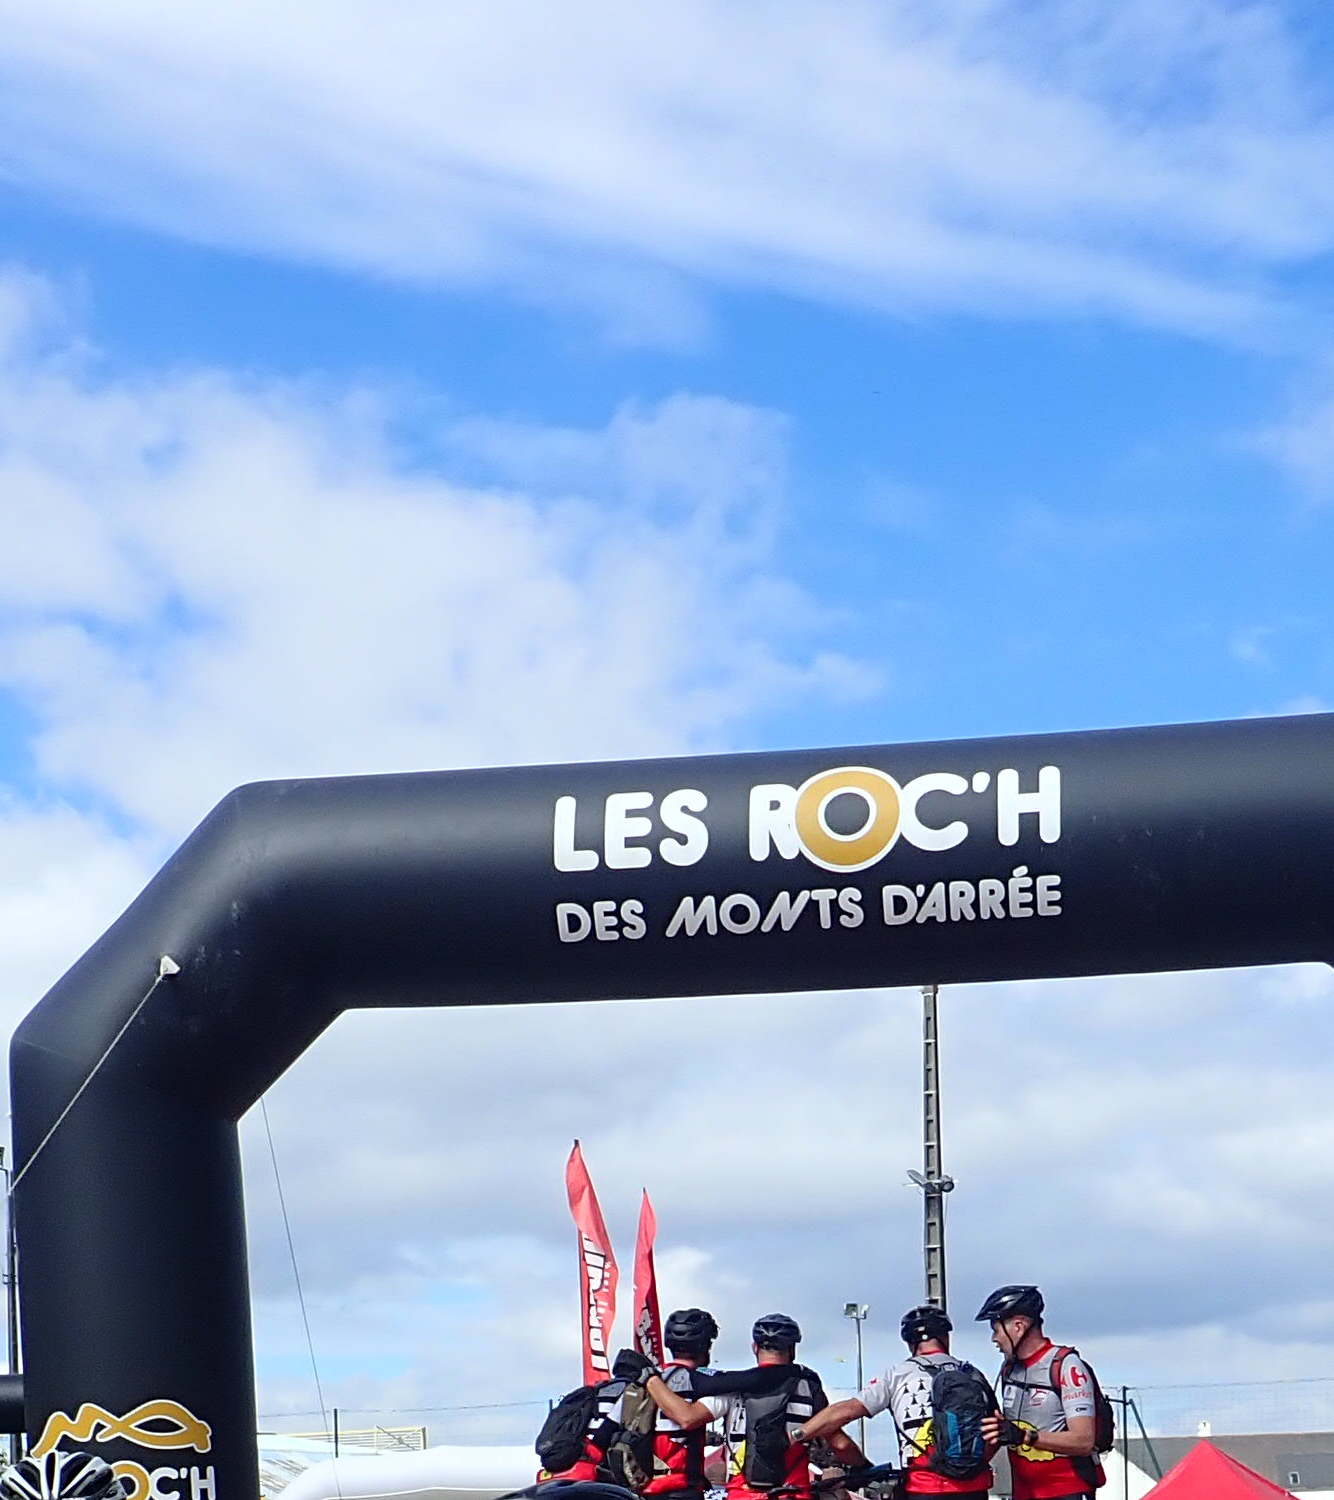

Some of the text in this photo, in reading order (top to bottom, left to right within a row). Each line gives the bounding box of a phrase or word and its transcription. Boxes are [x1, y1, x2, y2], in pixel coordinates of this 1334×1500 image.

[553, 765, 1062, 873] LES ROC'H
[556, 865, 1063, 943] DES MONTS D'ARRÉE
